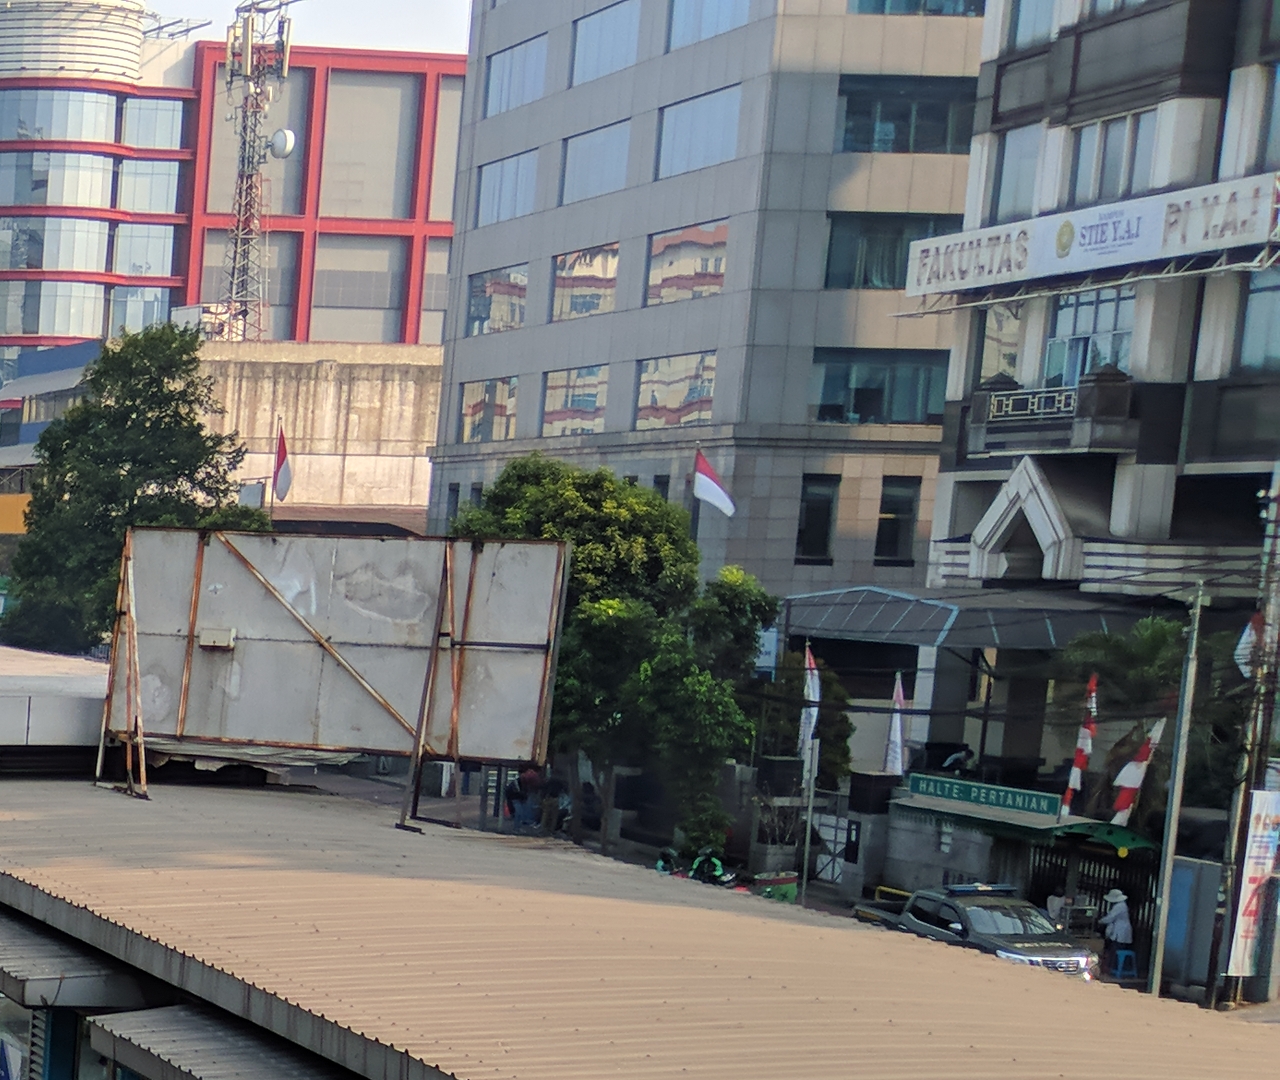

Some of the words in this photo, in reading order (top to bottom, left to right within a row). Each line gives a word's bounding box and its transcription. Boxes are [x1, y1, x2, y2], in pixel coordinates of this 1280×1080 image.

[1079, 222, 1108, 247] STIE
[915, 229, 1030, 288] FAKULTAS
[970, 786, 1049, 812] PERTANIAN
